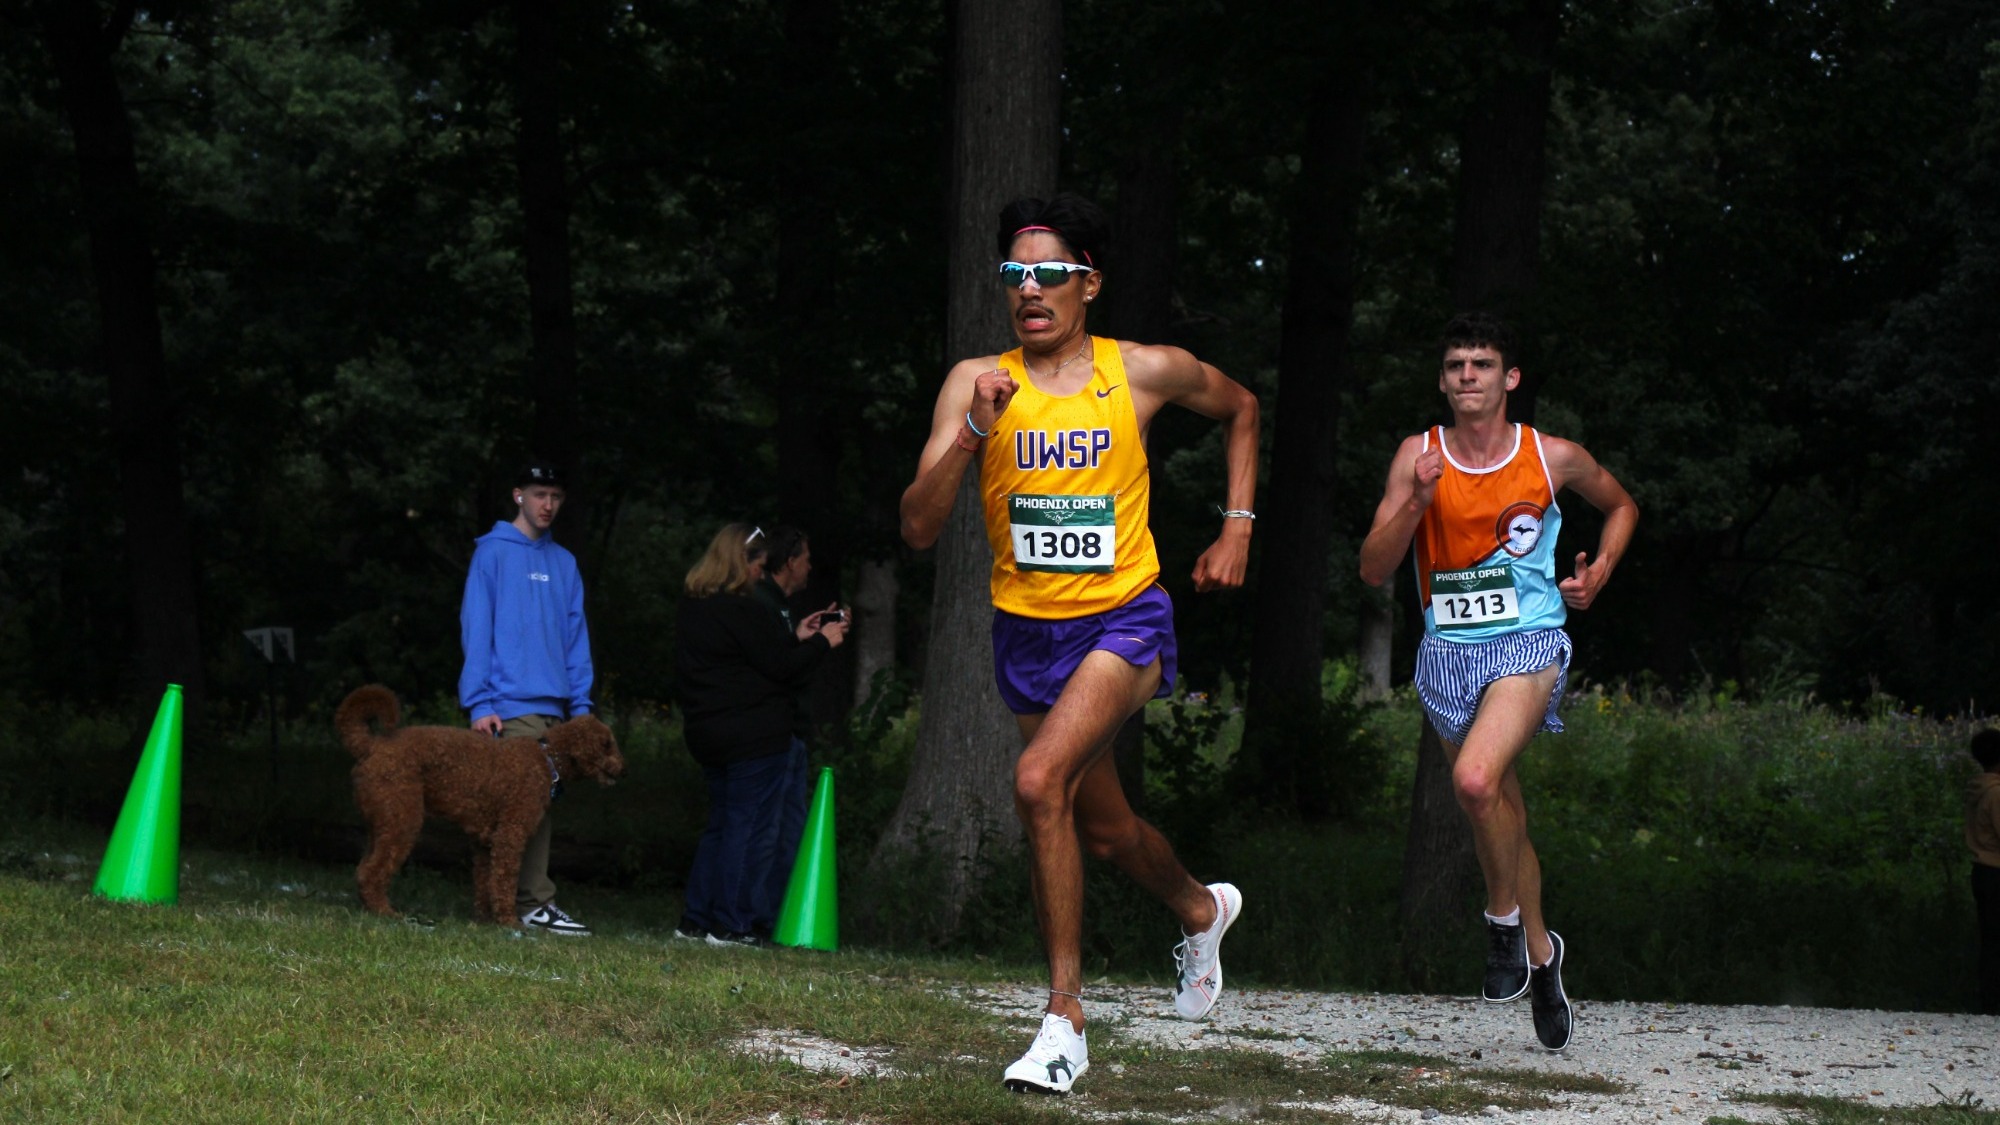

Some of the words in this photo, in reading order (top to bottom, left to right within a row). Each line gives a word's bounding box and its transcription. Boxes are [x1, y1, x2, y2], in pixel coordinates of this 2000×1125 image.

[1015, 428, 1111, 470] UWSP
[1015, 497, 1070, 509] PHOENIX
[1072, 498, 1106, 510] OPEN
[1023, 531, 1102, 559] 1308
[1435, 571, 1477, 582] PHOENIX
[1478, 567, 1506, 579] OPEN
[1444, 593, 1506, 619] 1213
